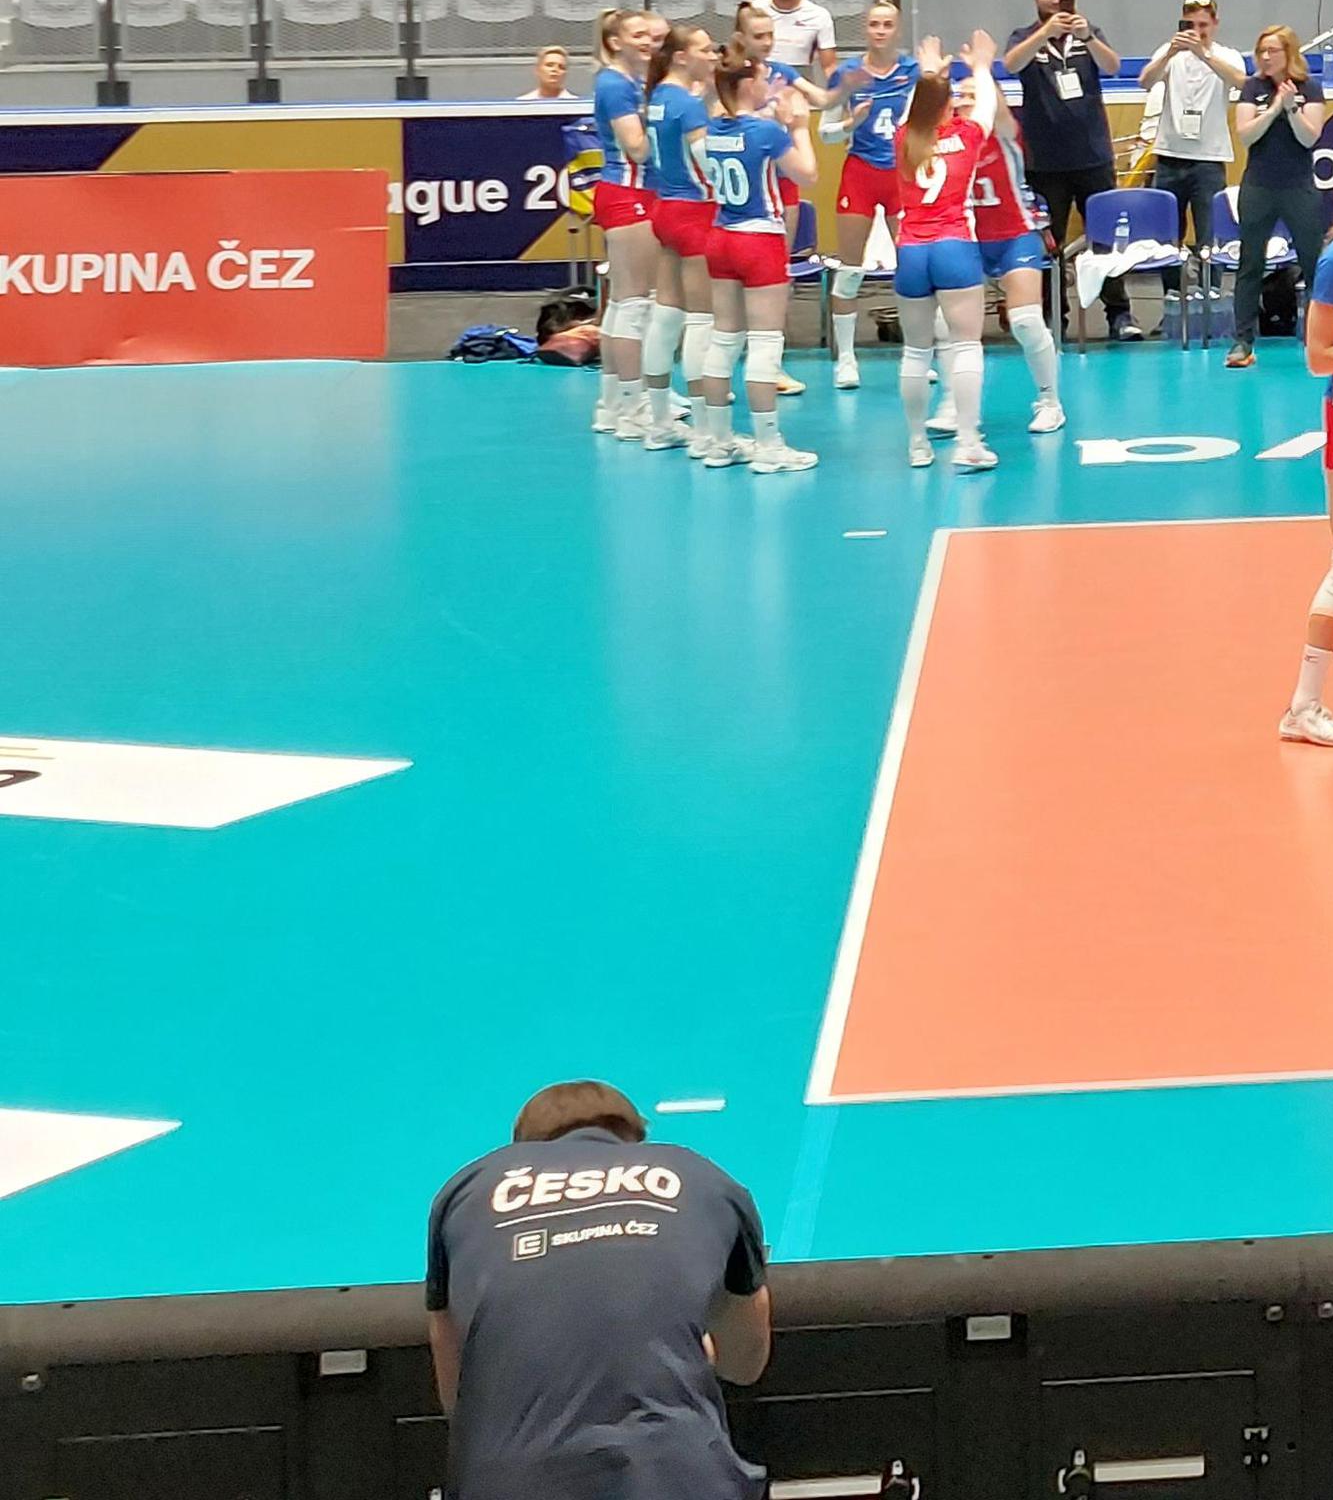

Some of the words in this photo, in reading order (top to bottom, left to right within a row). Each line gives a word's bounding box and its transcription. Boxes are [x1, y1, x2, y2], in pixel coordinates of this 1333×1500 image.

[873, 107, 896, 140] 4
[915, 155, 948, 205] 9
[206, 239, 316, 291] ČEZ
[492, 1165, 682, 1213] ČESKO
[550, 1222, 624, 1247] SKUPINA
[624, 1219, 659, 1236] ČEZ
